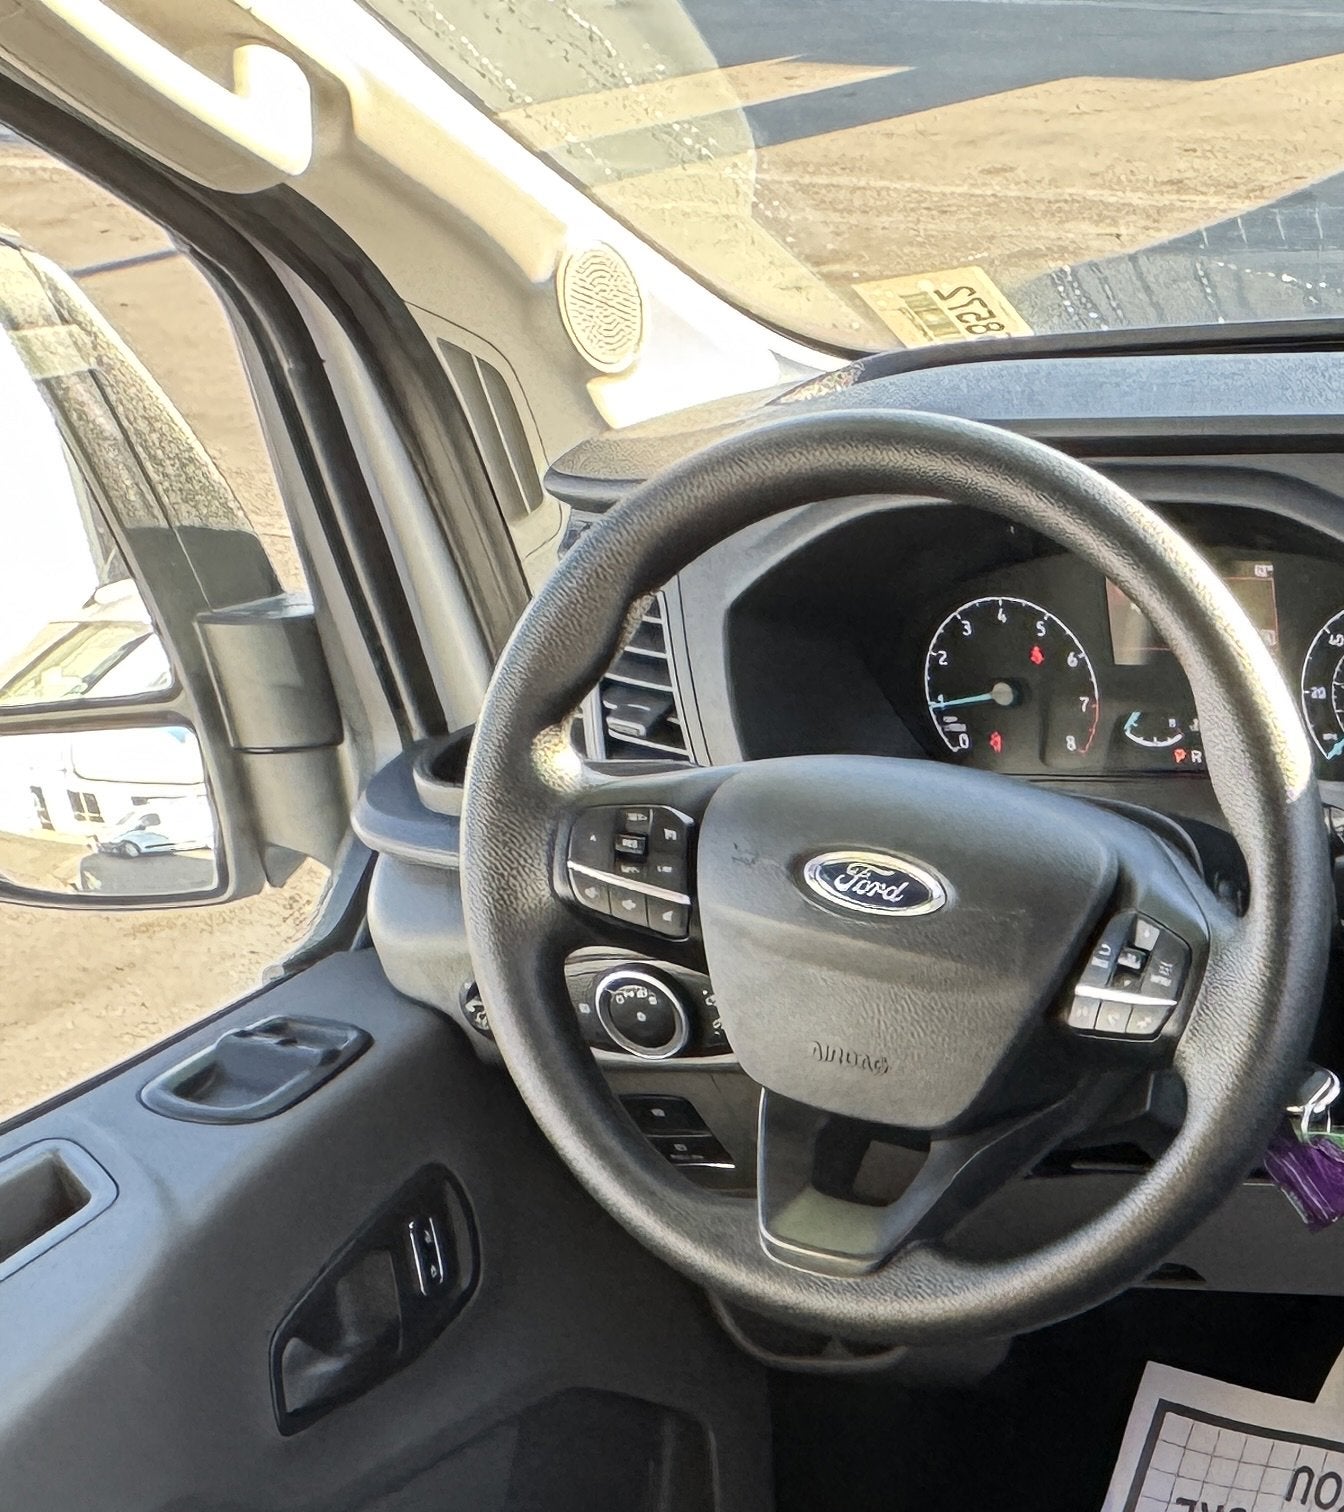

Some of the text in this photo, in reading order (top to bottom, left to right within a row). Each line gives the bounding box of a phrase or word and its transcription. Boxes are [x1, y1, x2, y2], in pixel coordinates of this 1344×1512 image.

[997, 608, 1008, 623] 4
[961, 620, 972, 636] 3
[1035, 621, 1047, 637] 5
[937, 651, 948, 666] 2
[1067, 652, 1079, 668] 6
[1079, 696, 1090, 712] 7
[958, 733, 970, 749] 0
[1065, 735, 1077, 751] 8
[834, 862, 910, 903] Ford
